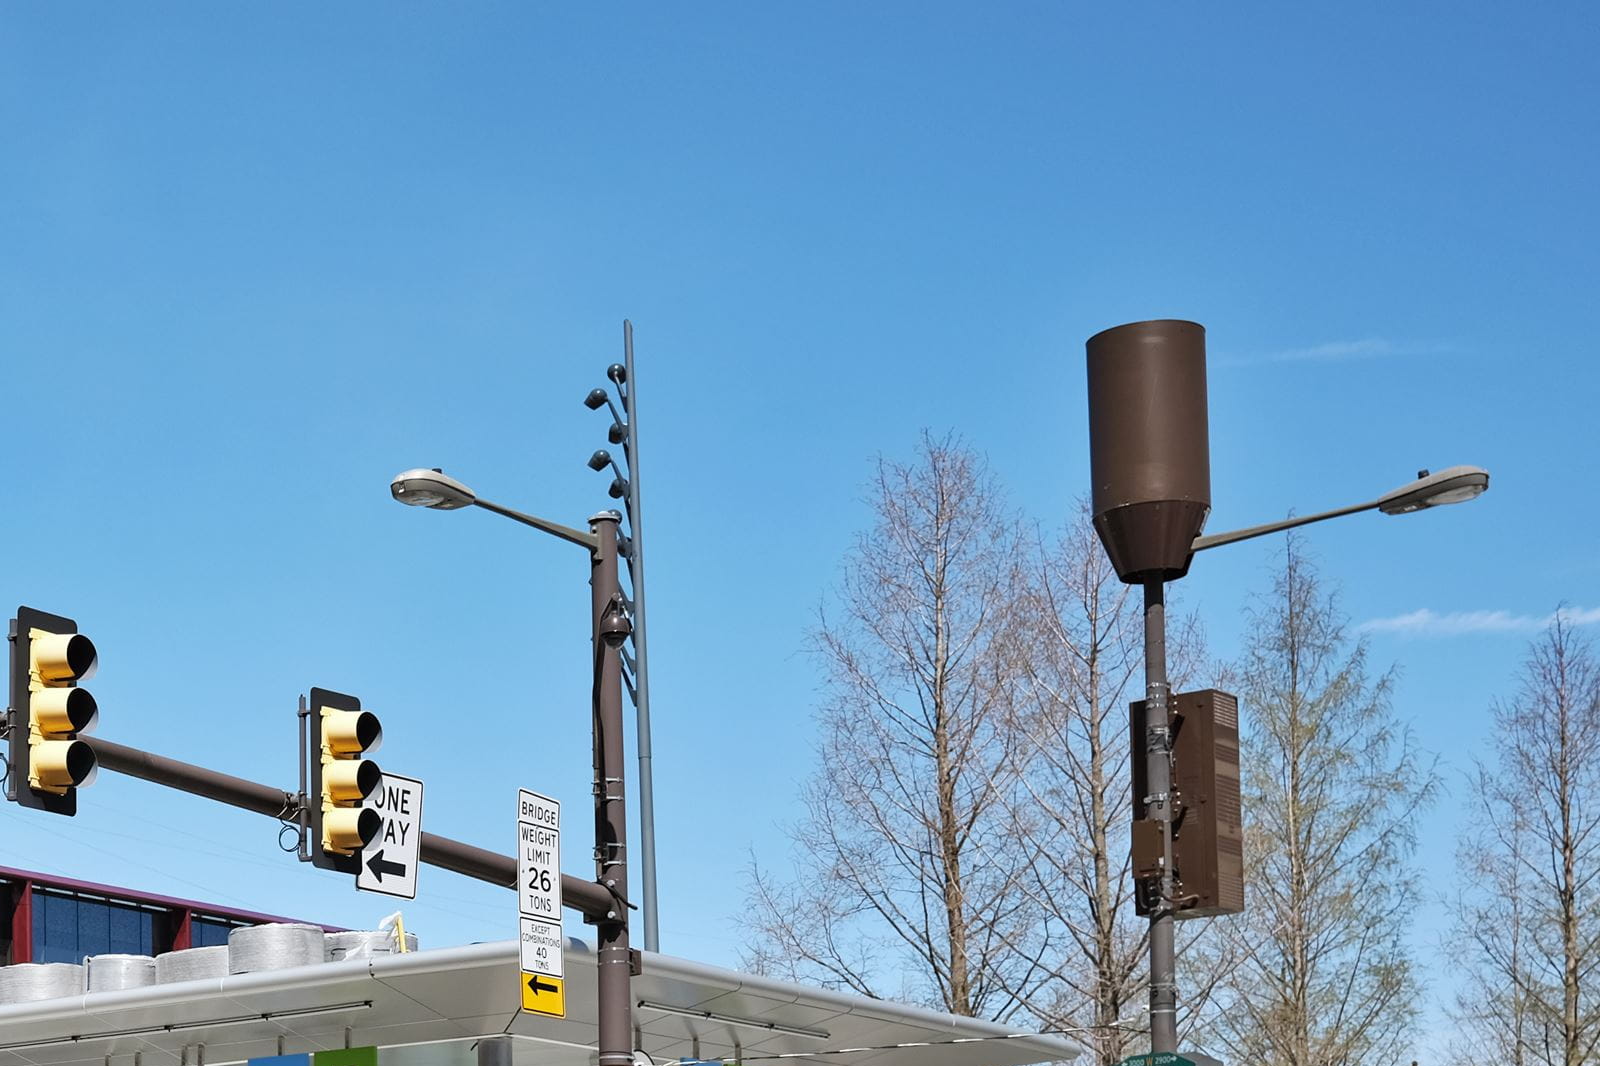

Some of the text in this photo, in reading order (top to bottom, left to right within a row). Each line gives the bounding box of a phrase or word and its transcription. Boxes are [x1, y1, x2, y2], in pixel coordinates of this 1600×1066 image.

[375, 785, 411, 815] ONE
[521, 800, 556, 826] BRIDGE
[382, 816, 410, 847] AY
[521, 826, 557, 848] WEIGHT
[527, 847, 551, 866] LIMIT
[528, 866, 551, 893] 26
[528, 893, 552, 913] TONS
[531, 923, 551, 936] EXCEPT
[521, 931, 561, 949] COMBINATIONS
[536, 946, 547, 959] 40
[534, 958, 549, 970] TONS
[1146, 1056, 1153, 1066] W
